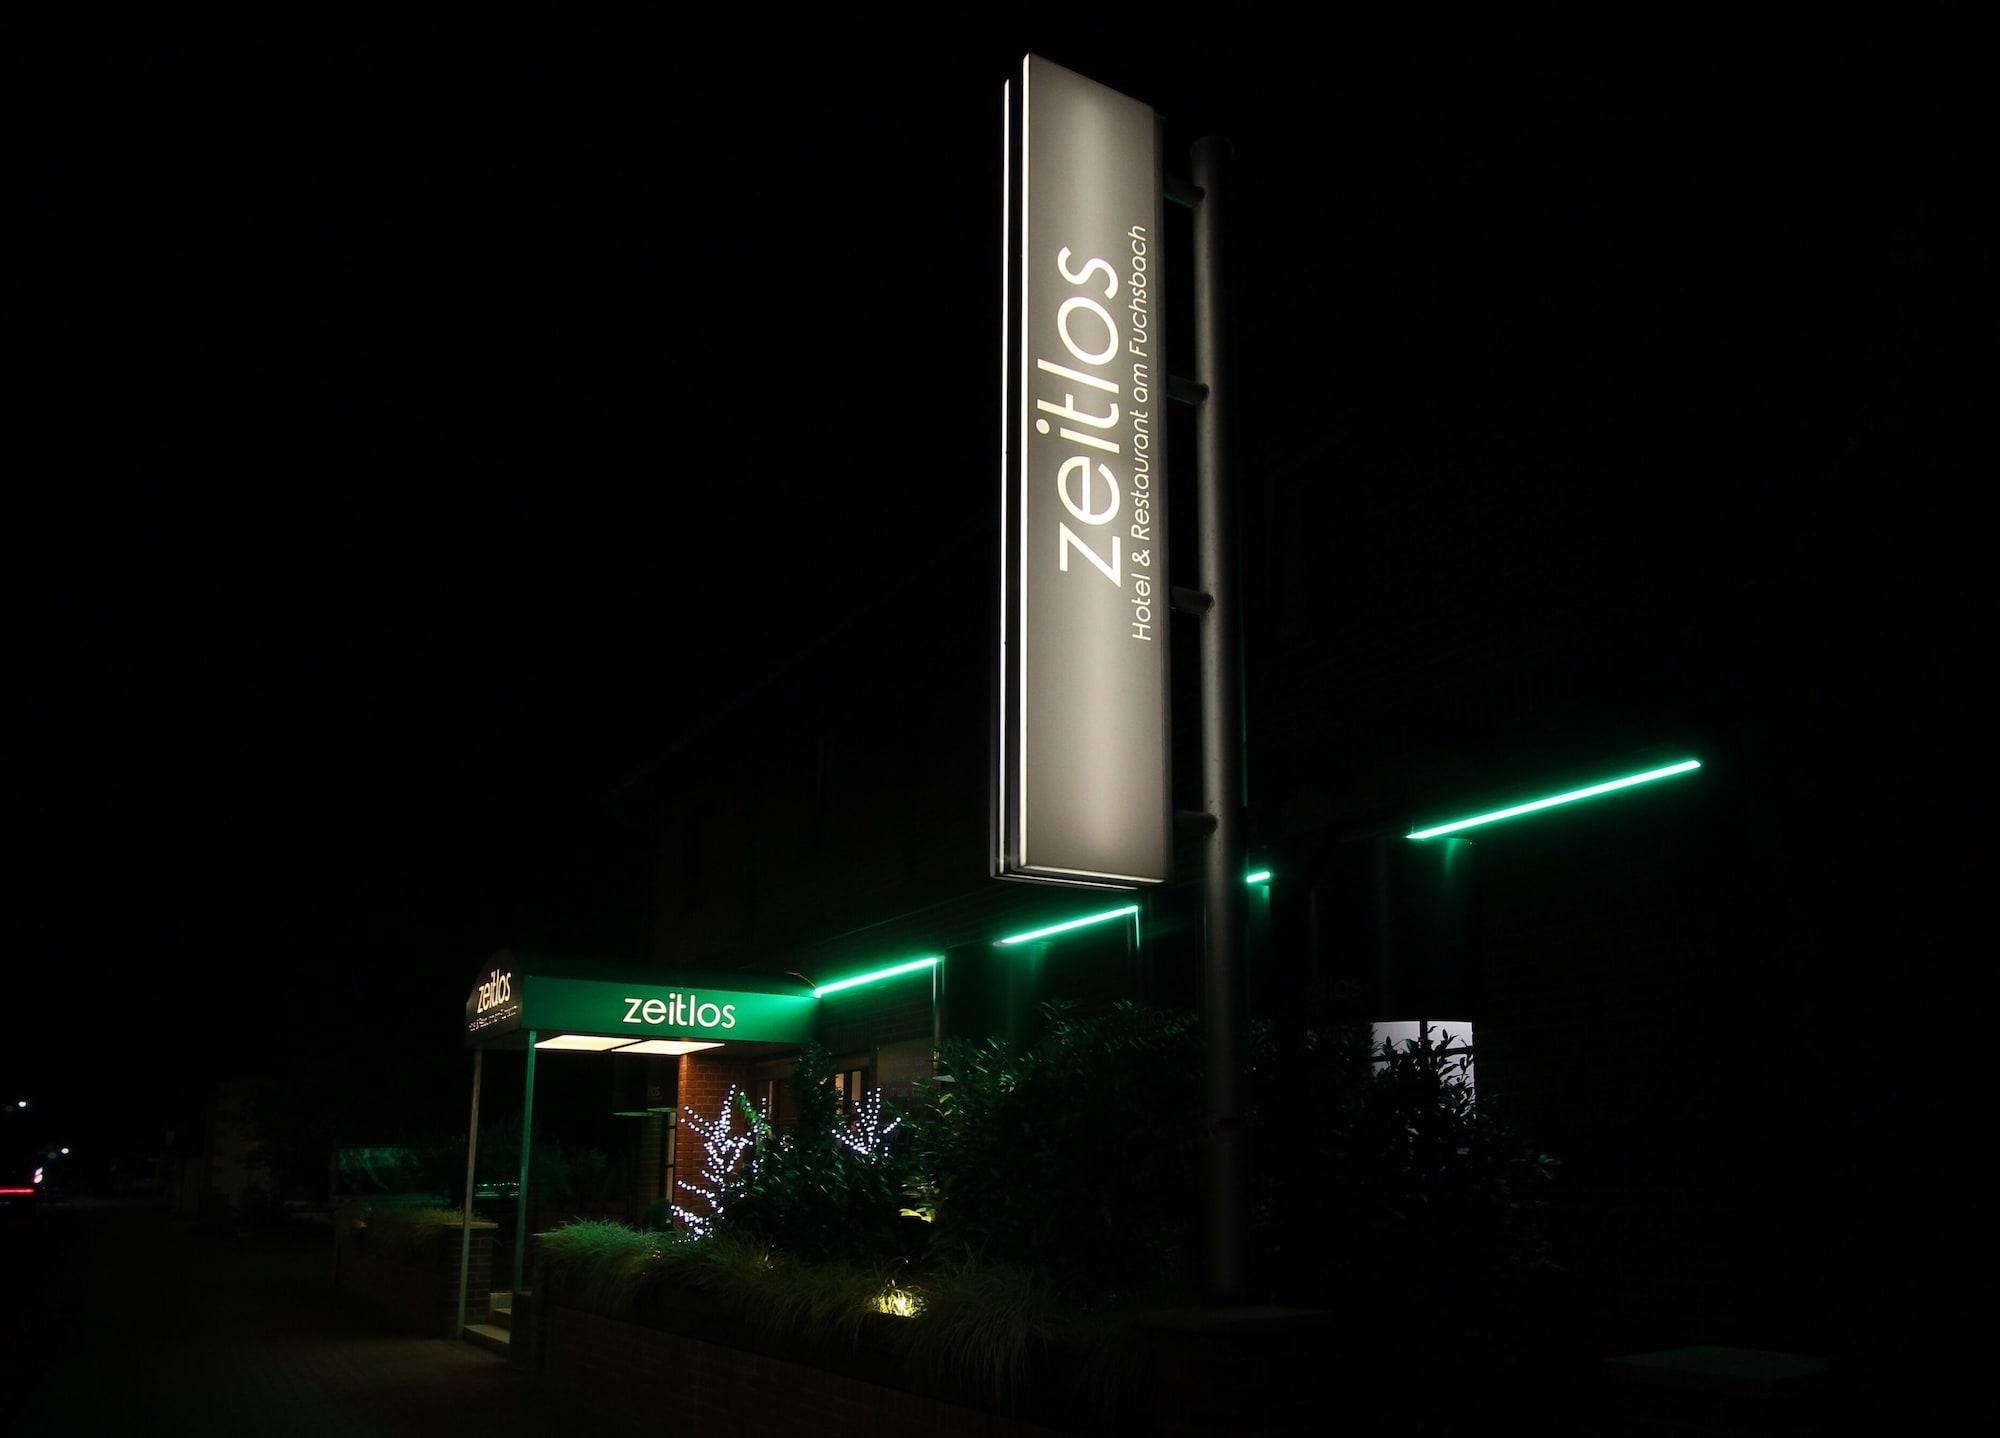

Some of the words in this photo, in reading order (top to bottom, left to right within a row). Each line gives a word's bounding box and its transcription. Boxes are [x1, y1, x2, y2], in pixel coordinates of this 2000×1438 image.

[1128, 226, 1147, 357] Fuchsbach
[1133, 364, 1148, 403] am
[1037, 247, 1121, 587] zeitlos
[1130, 410, 1150, 541] Restaurant
[1131, 550, 1151, 566] &
[1131, 573, 1151, 640] Hotel
[476, 969, 512, 1014] zeitlos
[623, 993, 737, 1028] zeitlos
